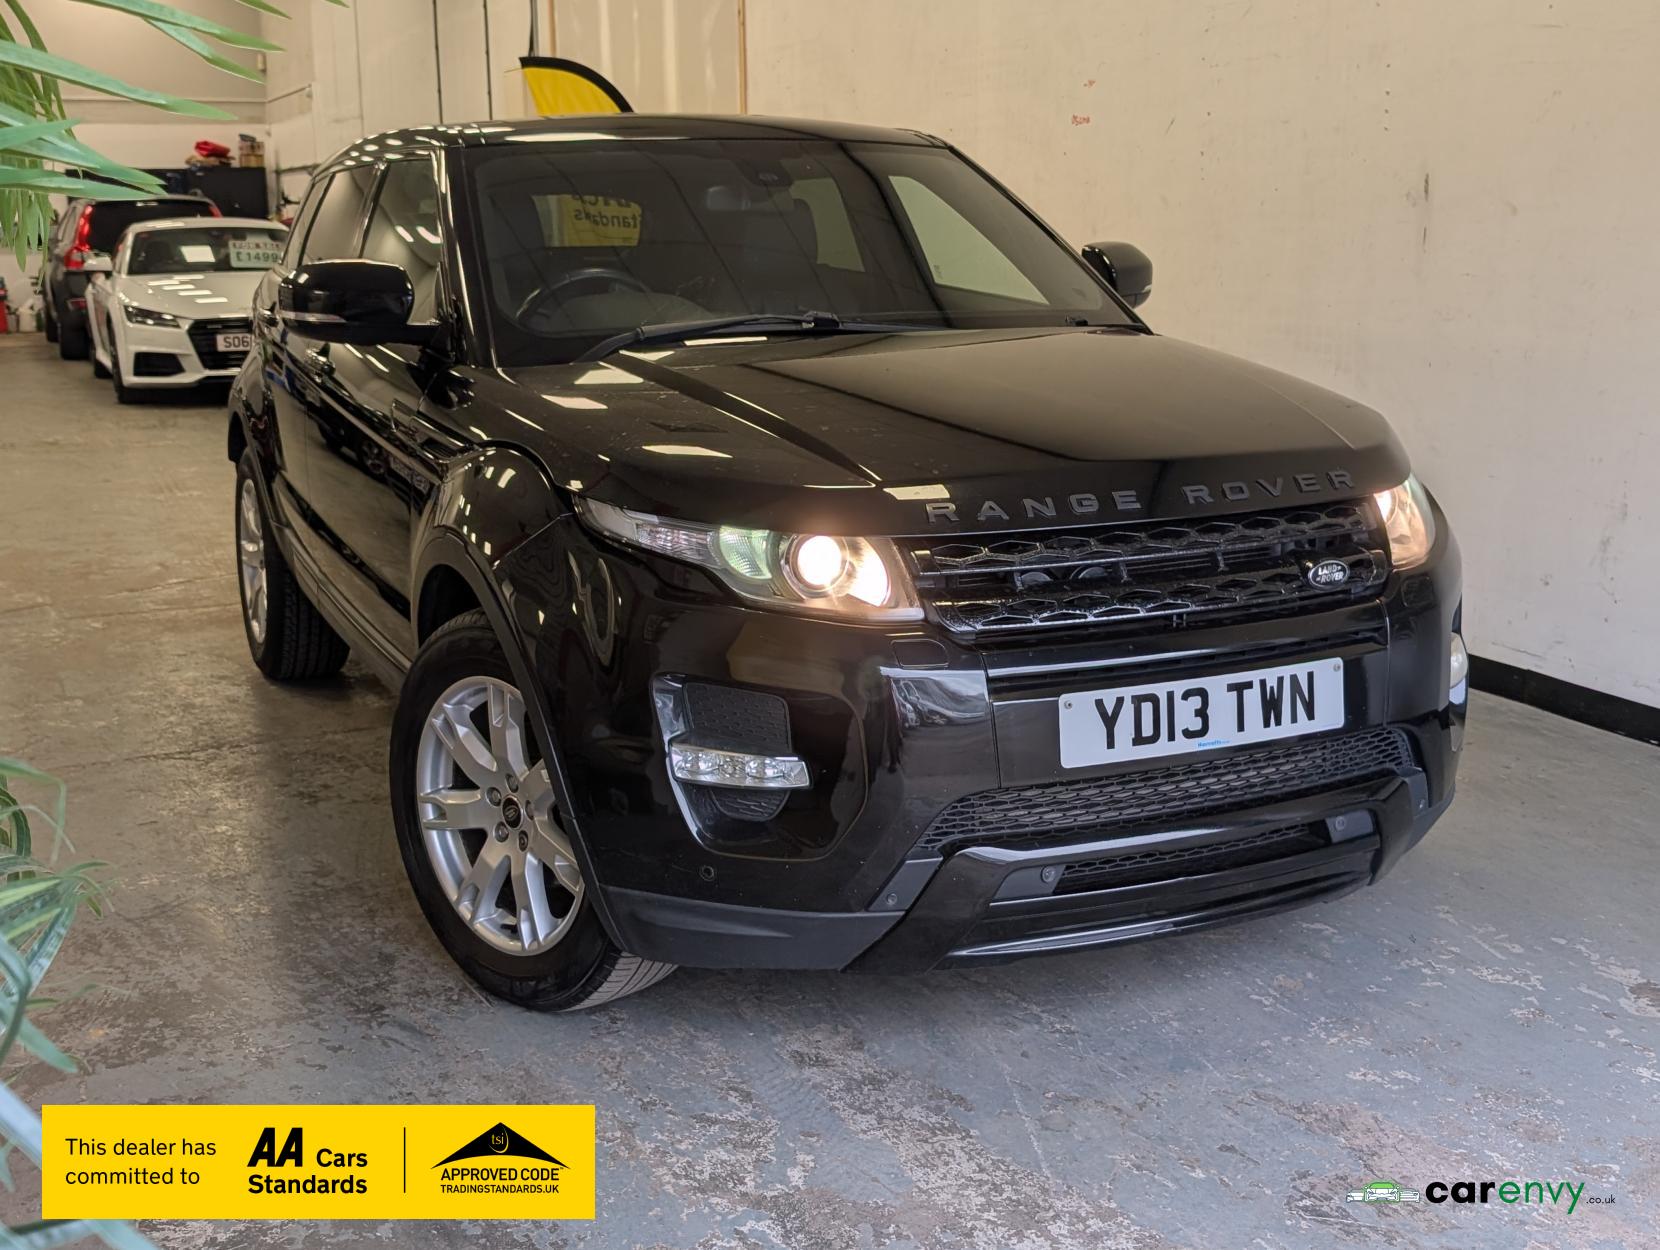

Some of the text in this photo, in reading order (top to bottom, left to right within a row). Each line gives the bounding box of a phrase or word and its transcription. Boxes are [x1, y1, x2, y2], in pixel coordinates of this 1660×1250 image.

[926, 469, 1356, 524] RANGE ROVER
[1094, 670, 1316, 750] YD13 TWN
